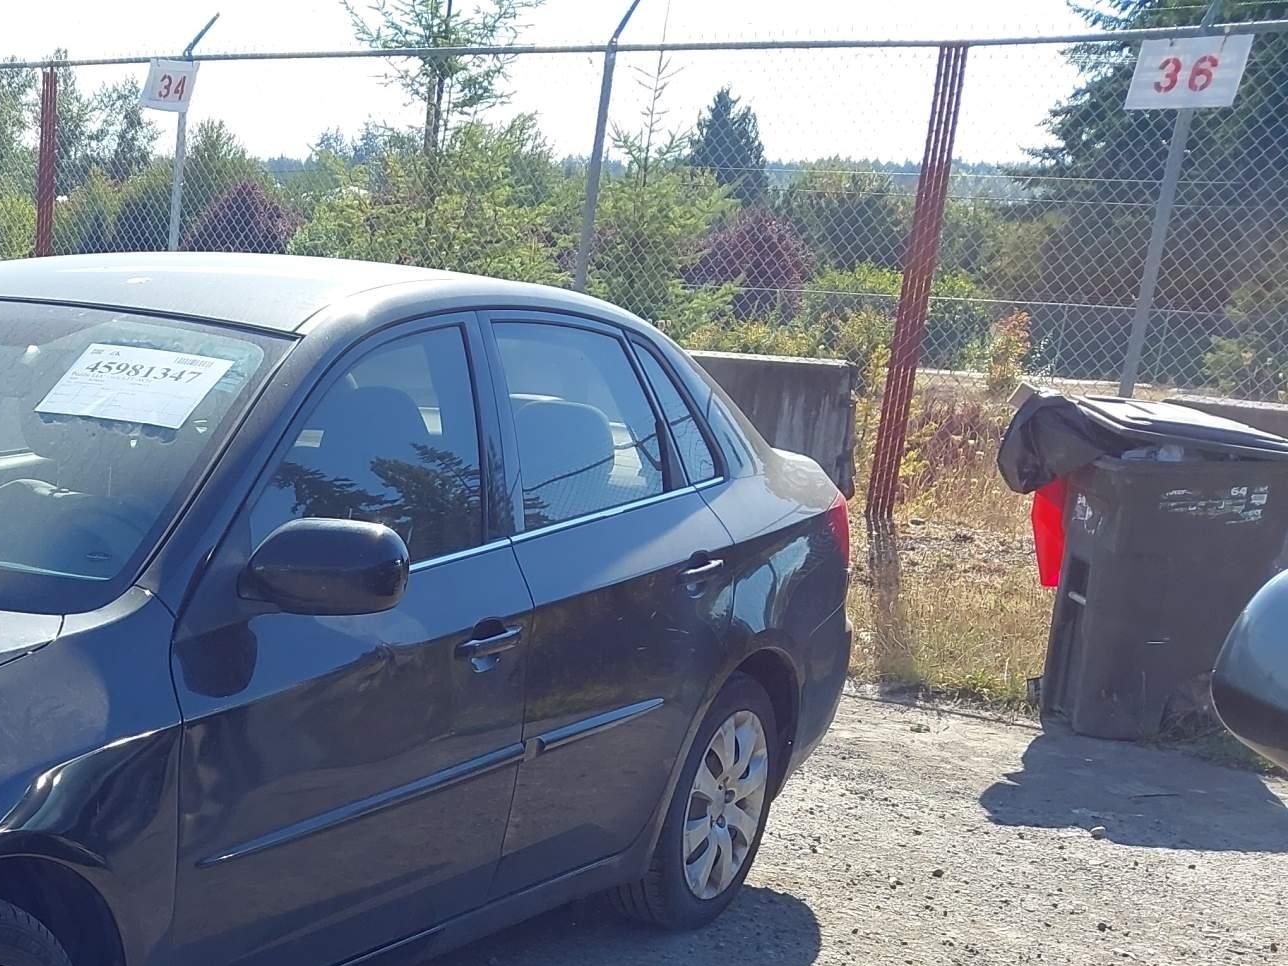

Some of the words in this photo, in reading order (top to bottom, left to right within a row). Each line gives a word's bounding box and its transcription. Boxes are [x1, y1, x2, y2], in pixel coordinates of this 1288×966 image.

[1153, 55, 1219, 93] 36
[158, 74, 187, 101] 34
[85, 360, 202, 384] 45981347
[1230, 487, 1249, 497] 64
